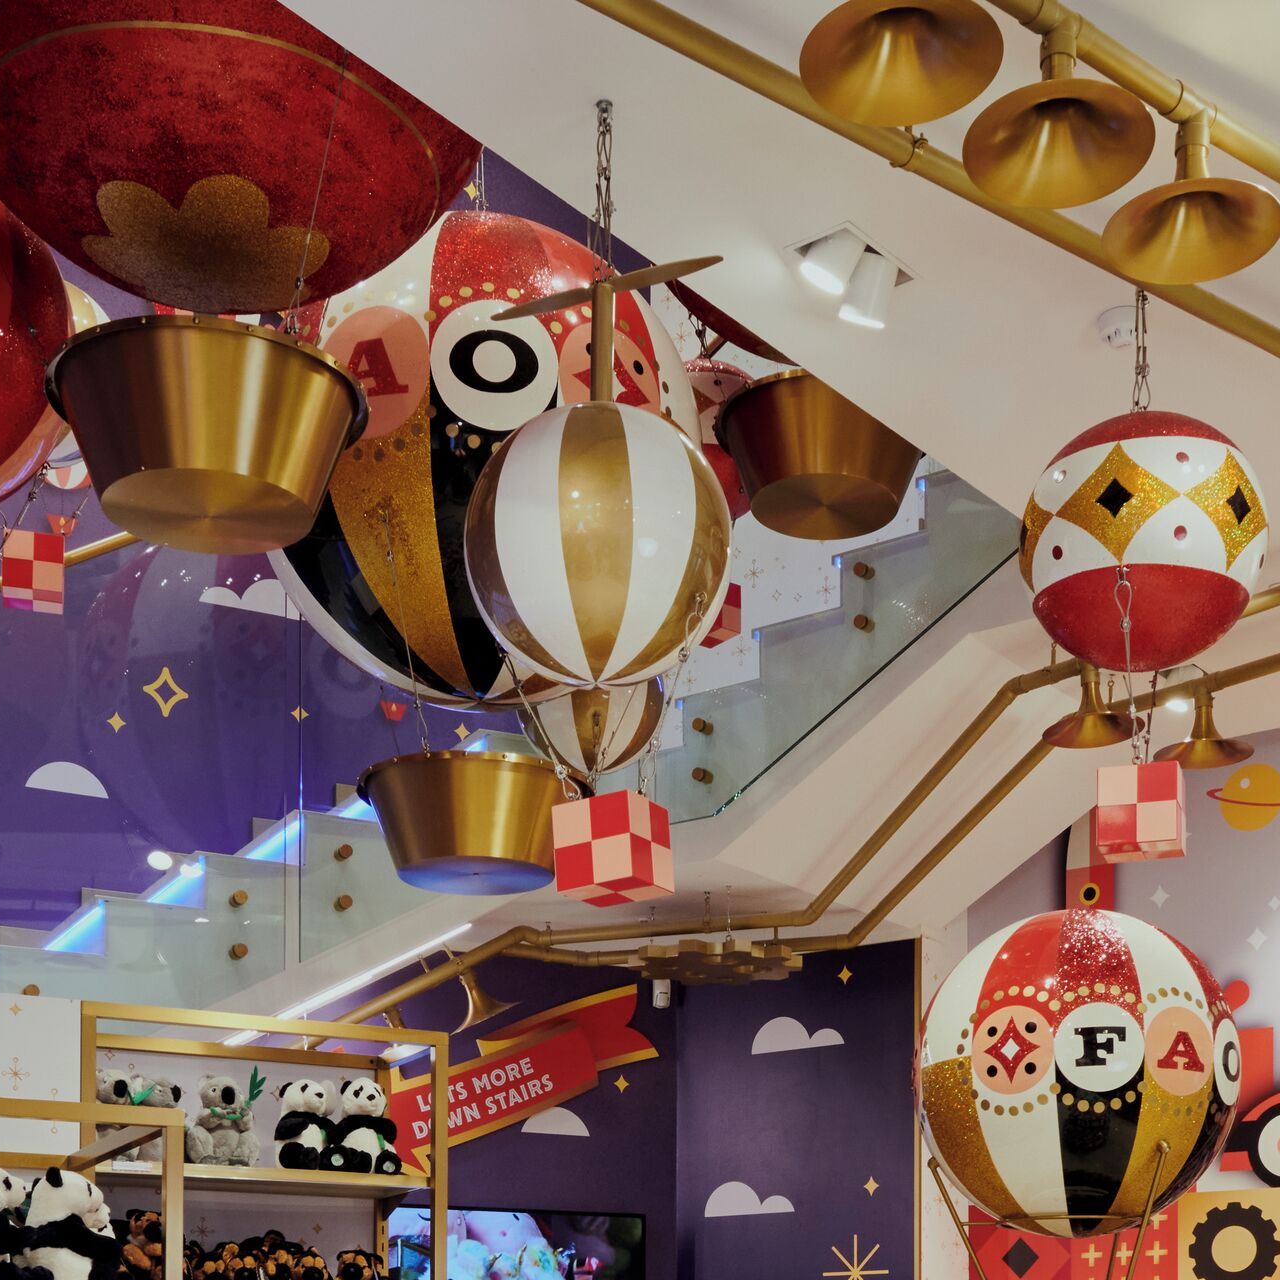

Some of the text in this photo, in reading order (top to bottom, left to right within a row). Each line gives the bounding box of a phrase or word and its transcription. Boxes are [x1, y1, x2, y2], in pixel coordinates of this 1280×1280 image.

[412, 1074, 554, 1140] DWN STAIRS
[416, 1057, 534, 1112] LTS MORE
